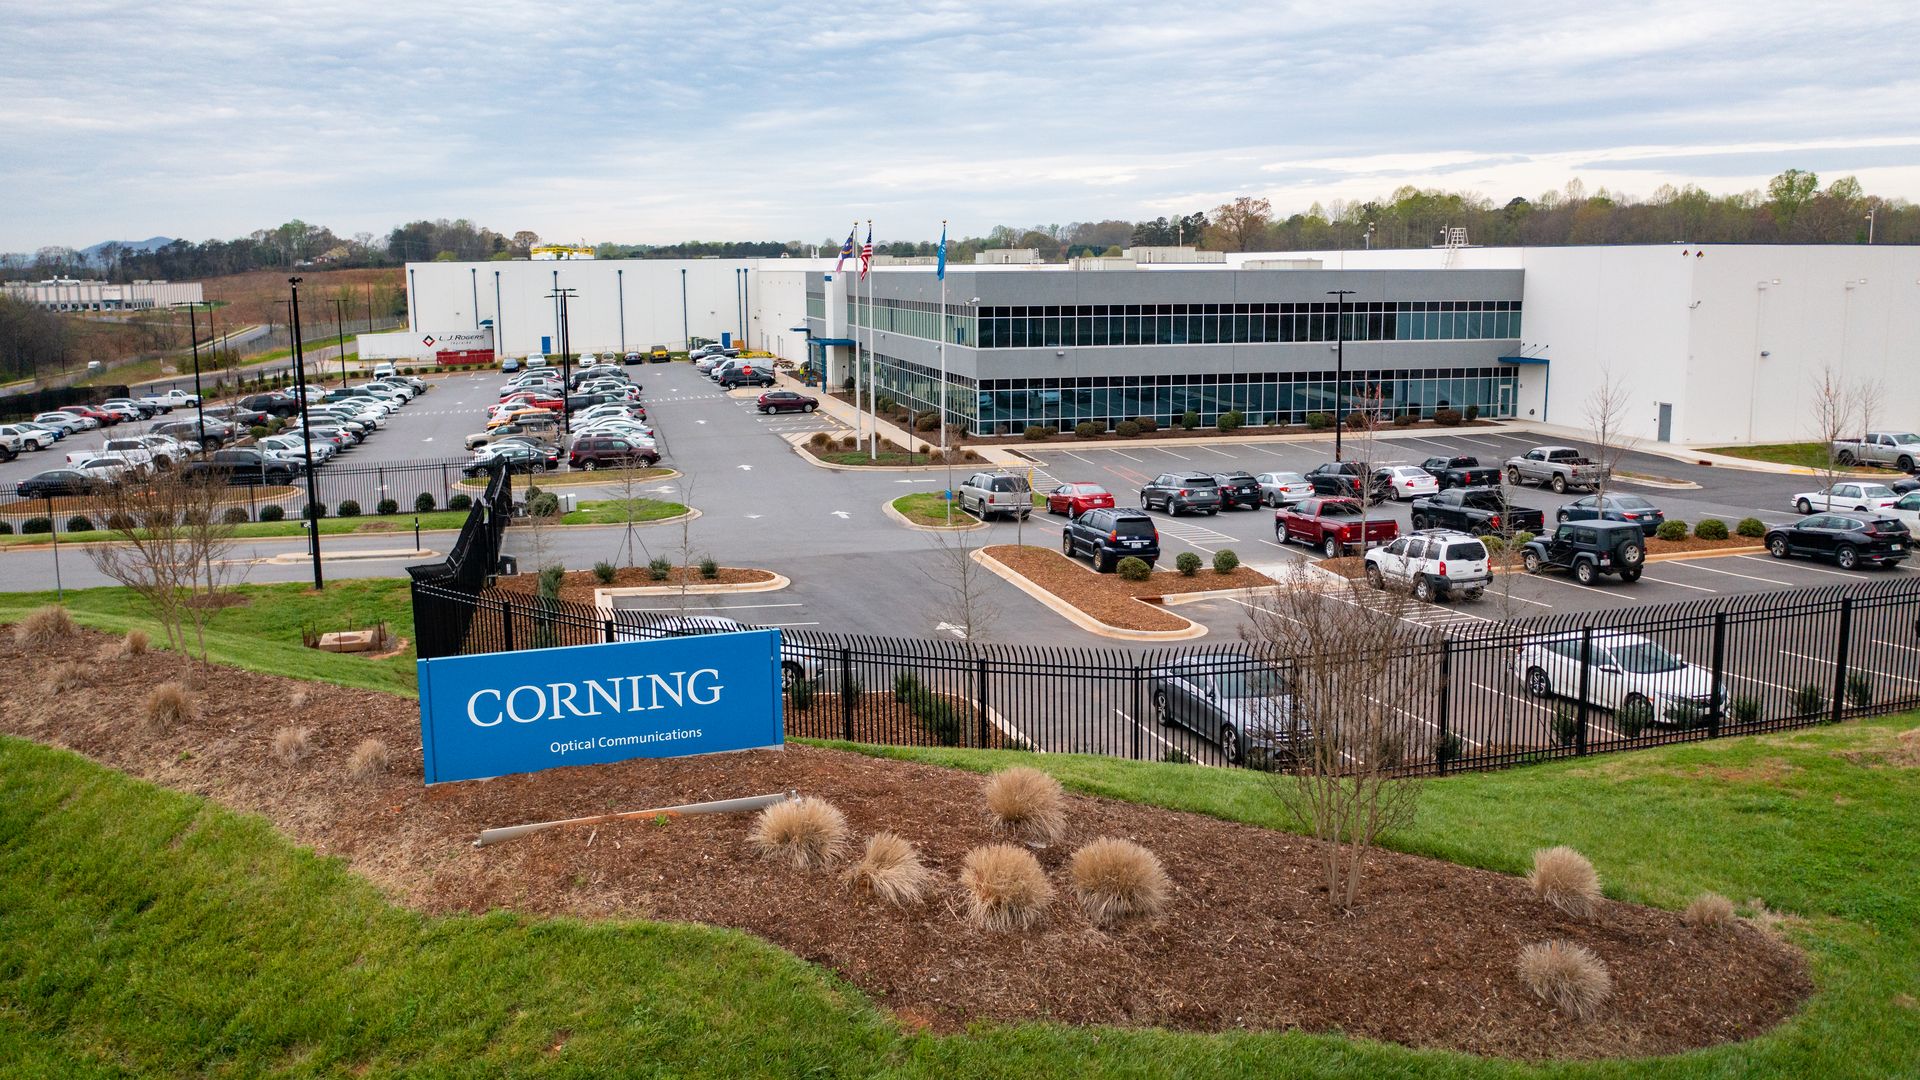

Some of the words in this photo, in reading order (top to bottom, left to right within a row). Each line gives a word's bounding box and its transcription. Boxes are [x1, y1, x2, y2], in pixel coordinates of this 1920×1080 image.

[467, 668, 725, 728] CORNING
[550, 737, 595, 755] Optical
[598, 727, 702, 749] Communications
